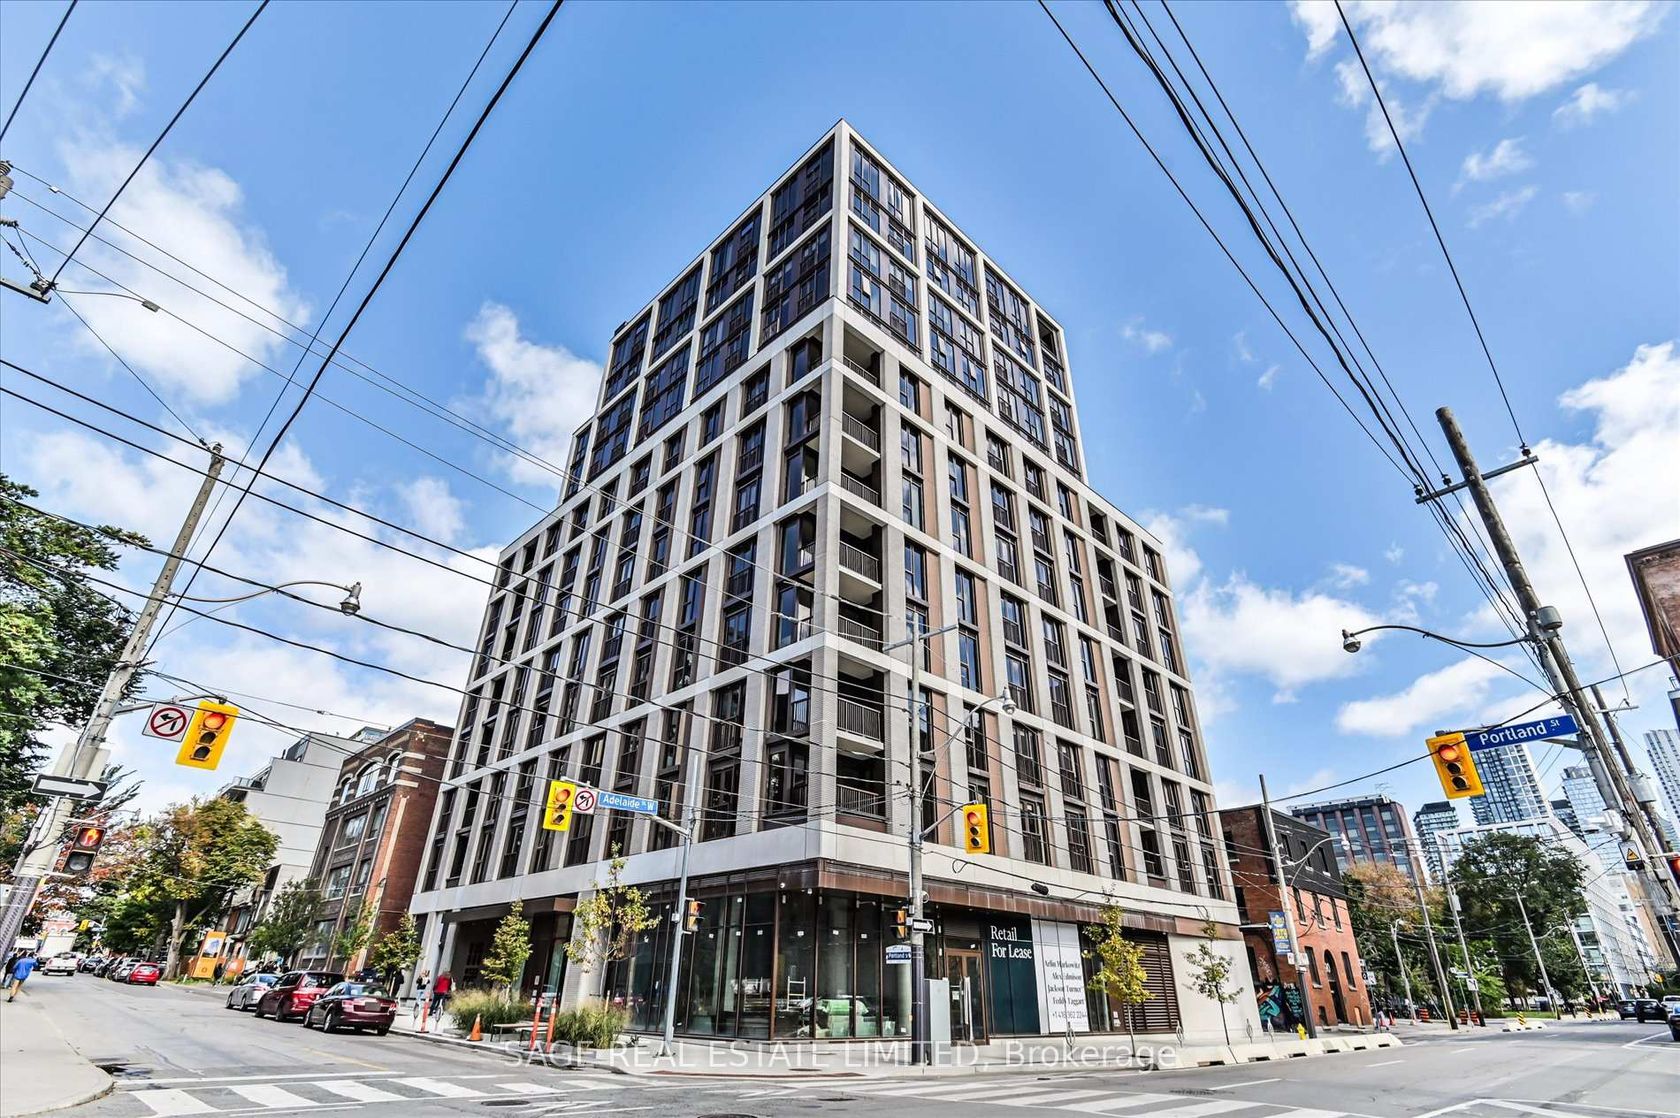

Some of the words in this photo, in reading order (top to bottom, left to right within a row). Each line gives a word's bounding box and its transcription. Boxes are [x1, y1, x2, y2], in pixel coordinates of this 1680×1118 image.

[1480, 722, 1547, 745] Portland
[1550, 719, 1560, 727] St
[603, 794, 640, 808] Adelaide
[647, 801, 655, 811] W
[990, 925, 1017, 941] Retail
[991, 943, 1007, 958] For
[1008, 944, 1033, 960] Lease
